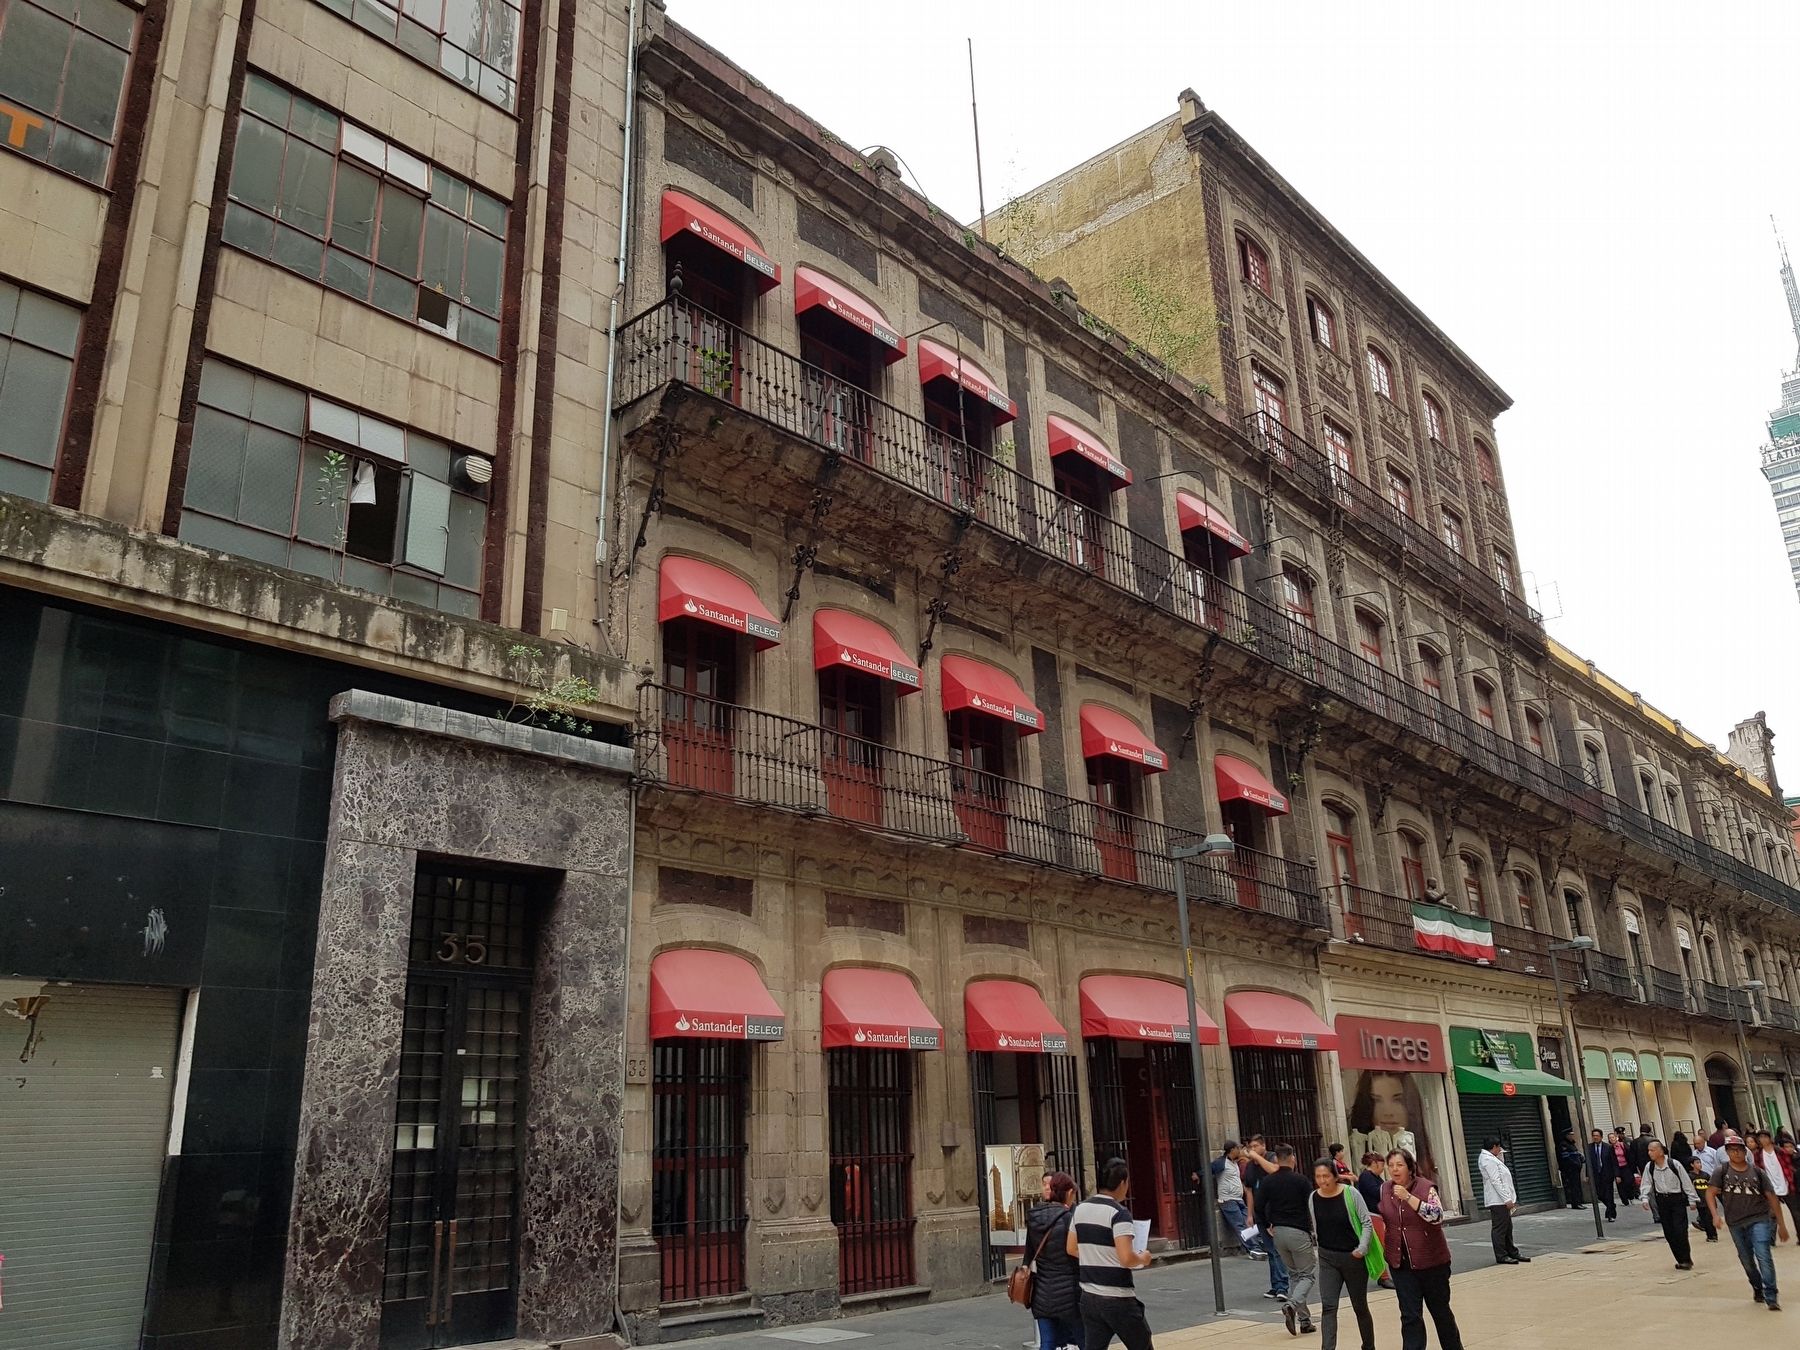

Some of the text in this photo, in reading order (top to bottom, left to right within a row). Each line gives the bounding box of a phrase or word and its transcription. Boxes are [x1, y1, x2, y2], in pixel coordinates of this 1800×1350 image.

[0, 102, 45, 147] T
[702, 226, 774, 274] Santander SELECT
[837, 304, 898, 345] Santander SELECT
[699, 604, 780, 638] Santander SELECT
[852, 653, 918, 683] Santander SELECT
[981, 698, 1037, 725] Santander SELECT
[1117, 744, 1143, 760] Santander
[436, 932, 487, 963] 35
[692, 1018, 783, 1035] Santander SELECT
[867, 1030, 938, 1045] Santander SELECT
[1146, 1026, 1172, 1038] Santander
[1007, 1036, 1067, 1049] Santander SELECT
[1360, 1028, 1431, 1062] lineas
[628, 1059, 647, 1077] 33
